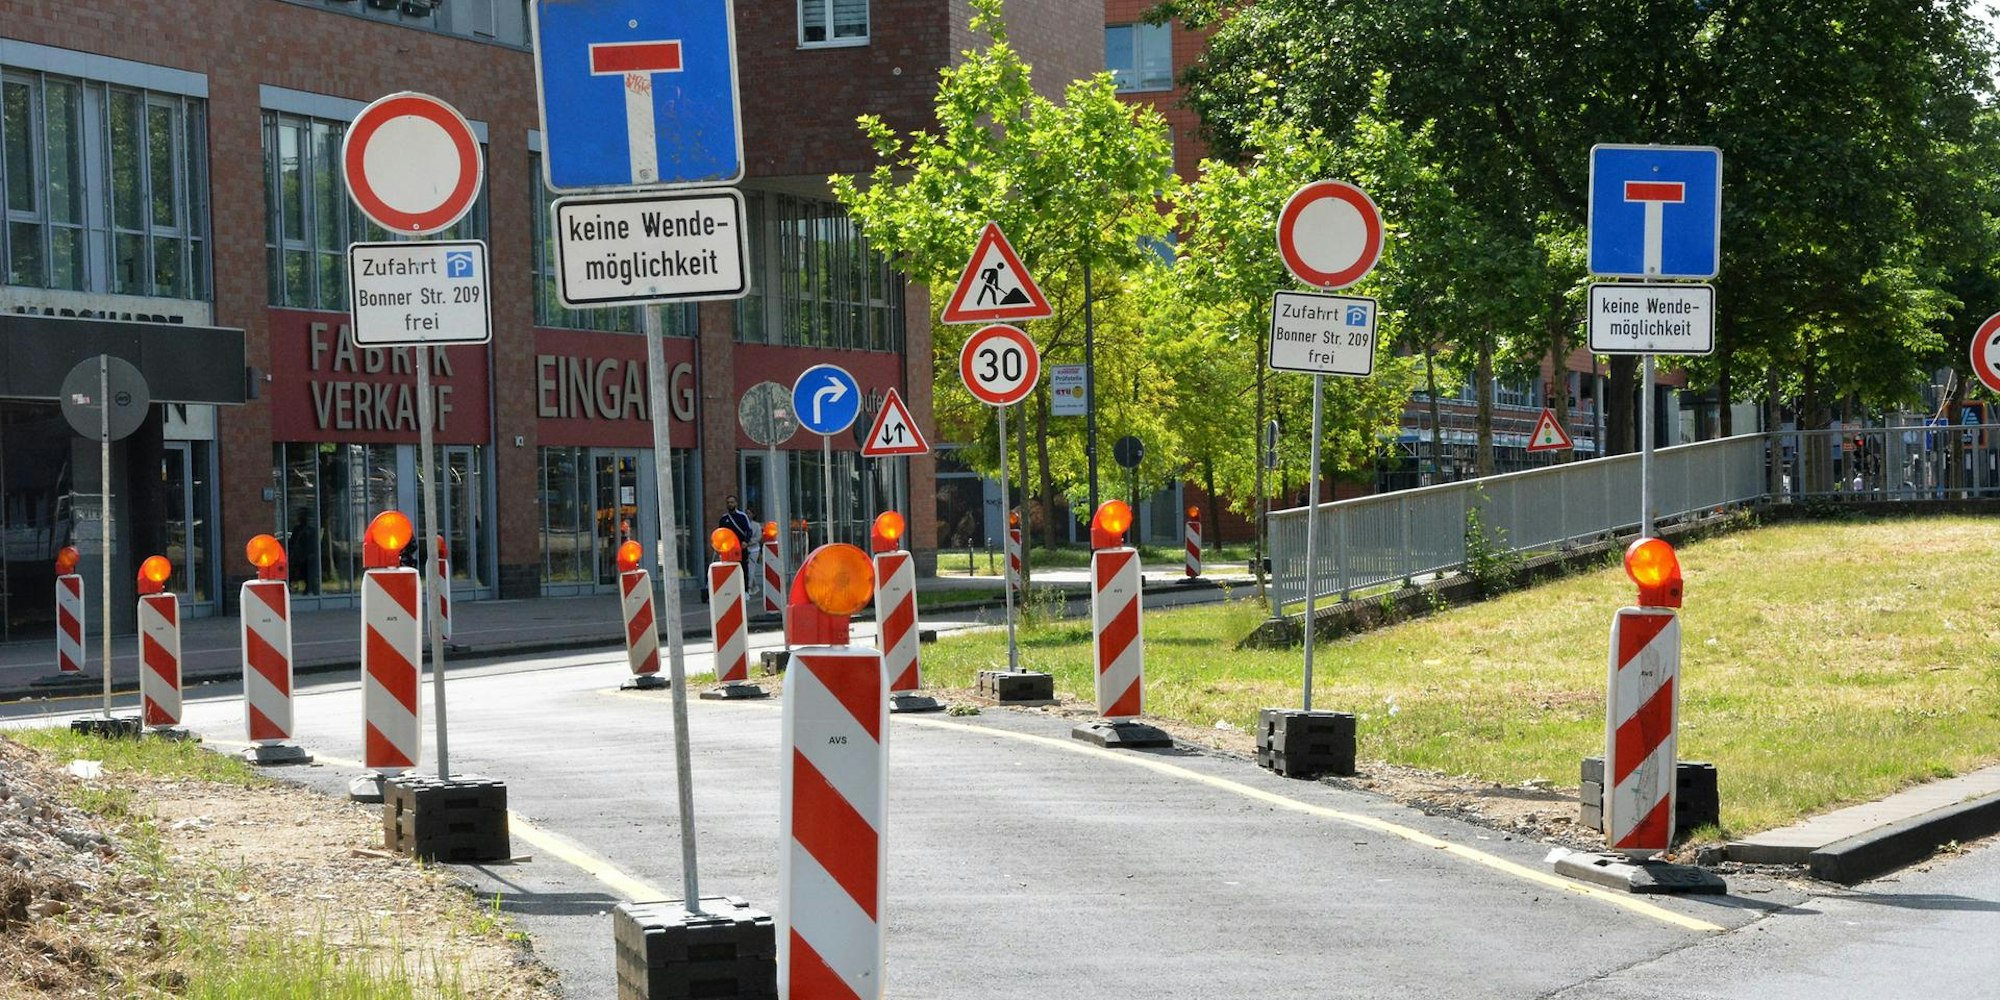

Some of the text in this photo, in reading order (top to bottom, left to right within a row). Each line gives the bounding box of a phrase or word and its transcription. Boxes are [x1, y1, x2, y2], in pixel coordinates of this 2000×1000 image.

[569, 210, 729, 242] keine Wende-
[362, 257, 437, 276] Zufahrt
[586, 249, 719, 286] möglichkeit
[359, 286, 480, 307] Bonner Str. 209
[1602, 297, 1700, 314] keine Wende-
[404, 312, 440, 331] frei
[1282, 303, 1340, 321] Zufahrt
[1276, 326, 1369, 347] Bonner Str. 209
[1610, 319, 1692, 340] möglichkeit
[310, 321, 454, 377] FABRK
[1308, 349, 1335, 364] frei
[978, 347, 1022, 382] 30
[828, 736, 848, 744] AVS
